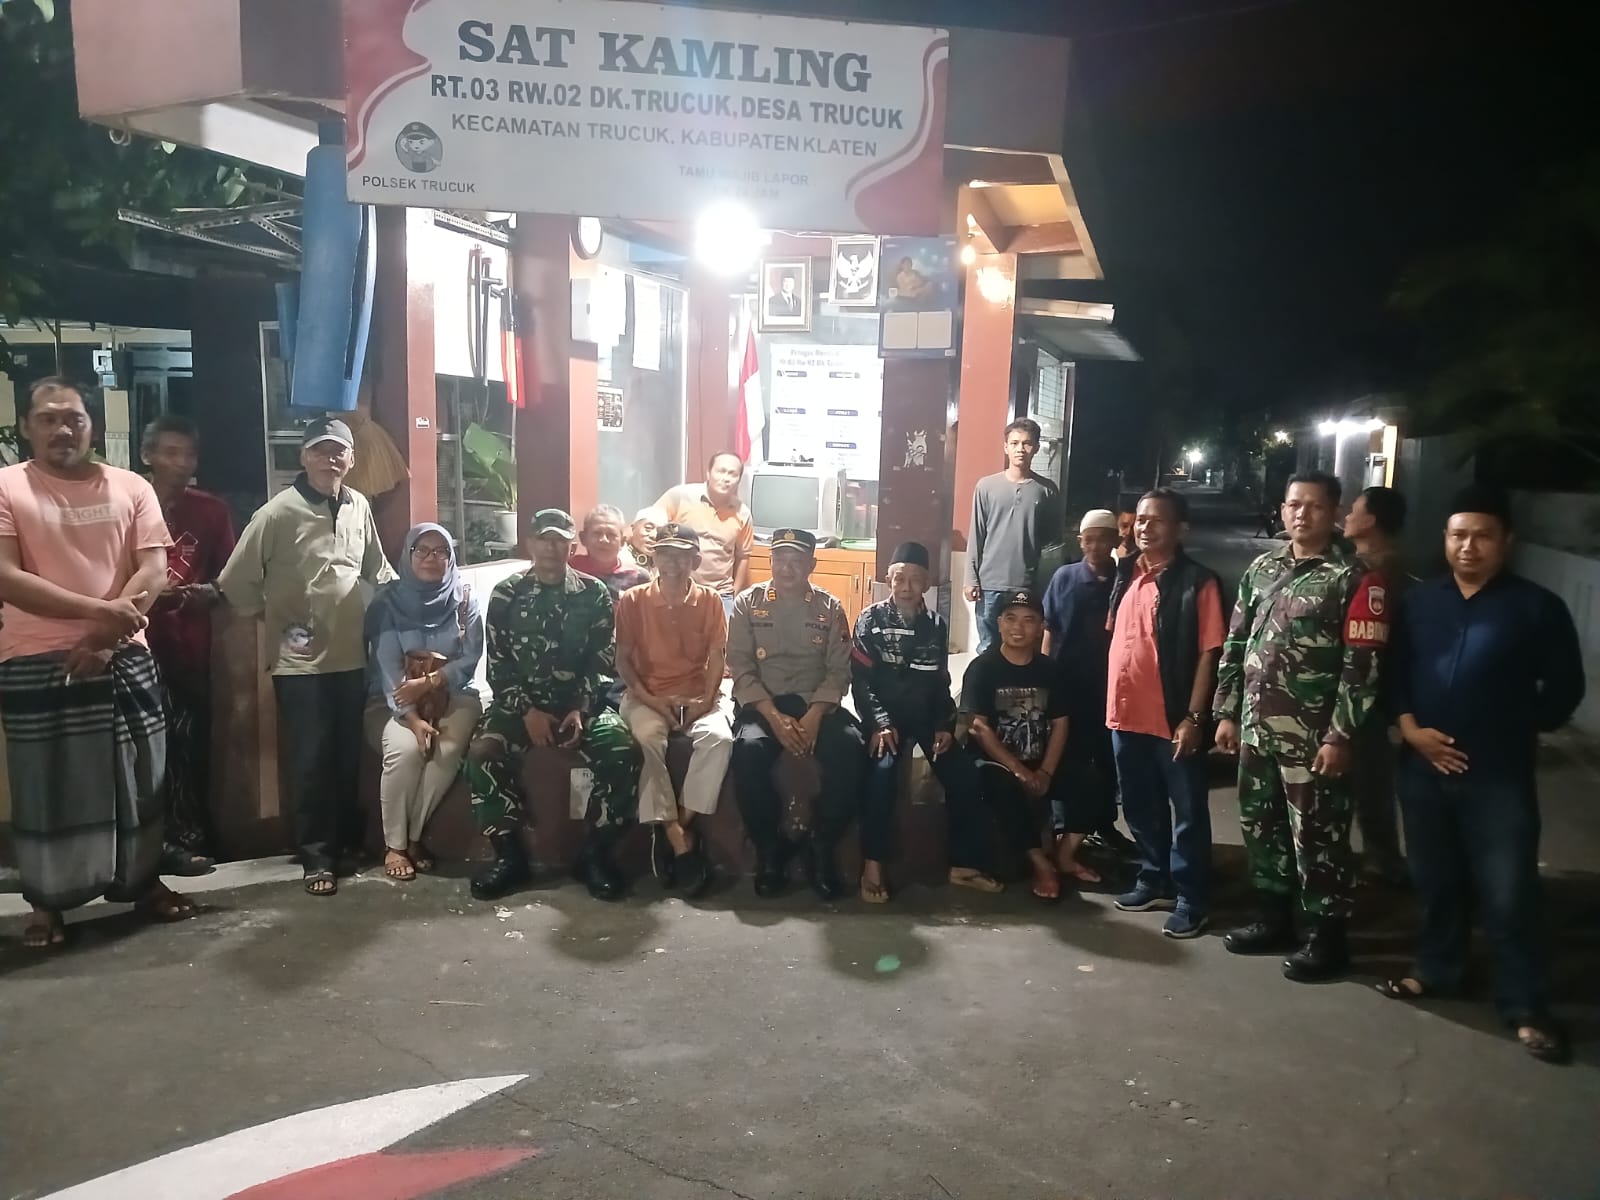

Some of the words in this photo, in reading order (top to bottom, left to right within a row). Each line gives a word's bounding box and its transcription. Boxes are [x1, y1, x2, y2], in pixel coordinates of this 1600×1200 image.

[458, 19, 575, 68] SAT
[598, 31, 872, 92] KAMLING
[431, 74, 499, 101] RT.03
[508, 80, 581, 107] RW.02
[810, 101, 903, 130] TRUCUK
[452, 113, 580, 138] KECAMATAN
[681, 128, 799, 152] KABUPATEN
[803, 137, 877, 157] KLATEN
[362, 175, 416, 190] POLSEK
[421, 179, 475, 193] TRUCUK
[764, 170, 809, 185] LAPOR
